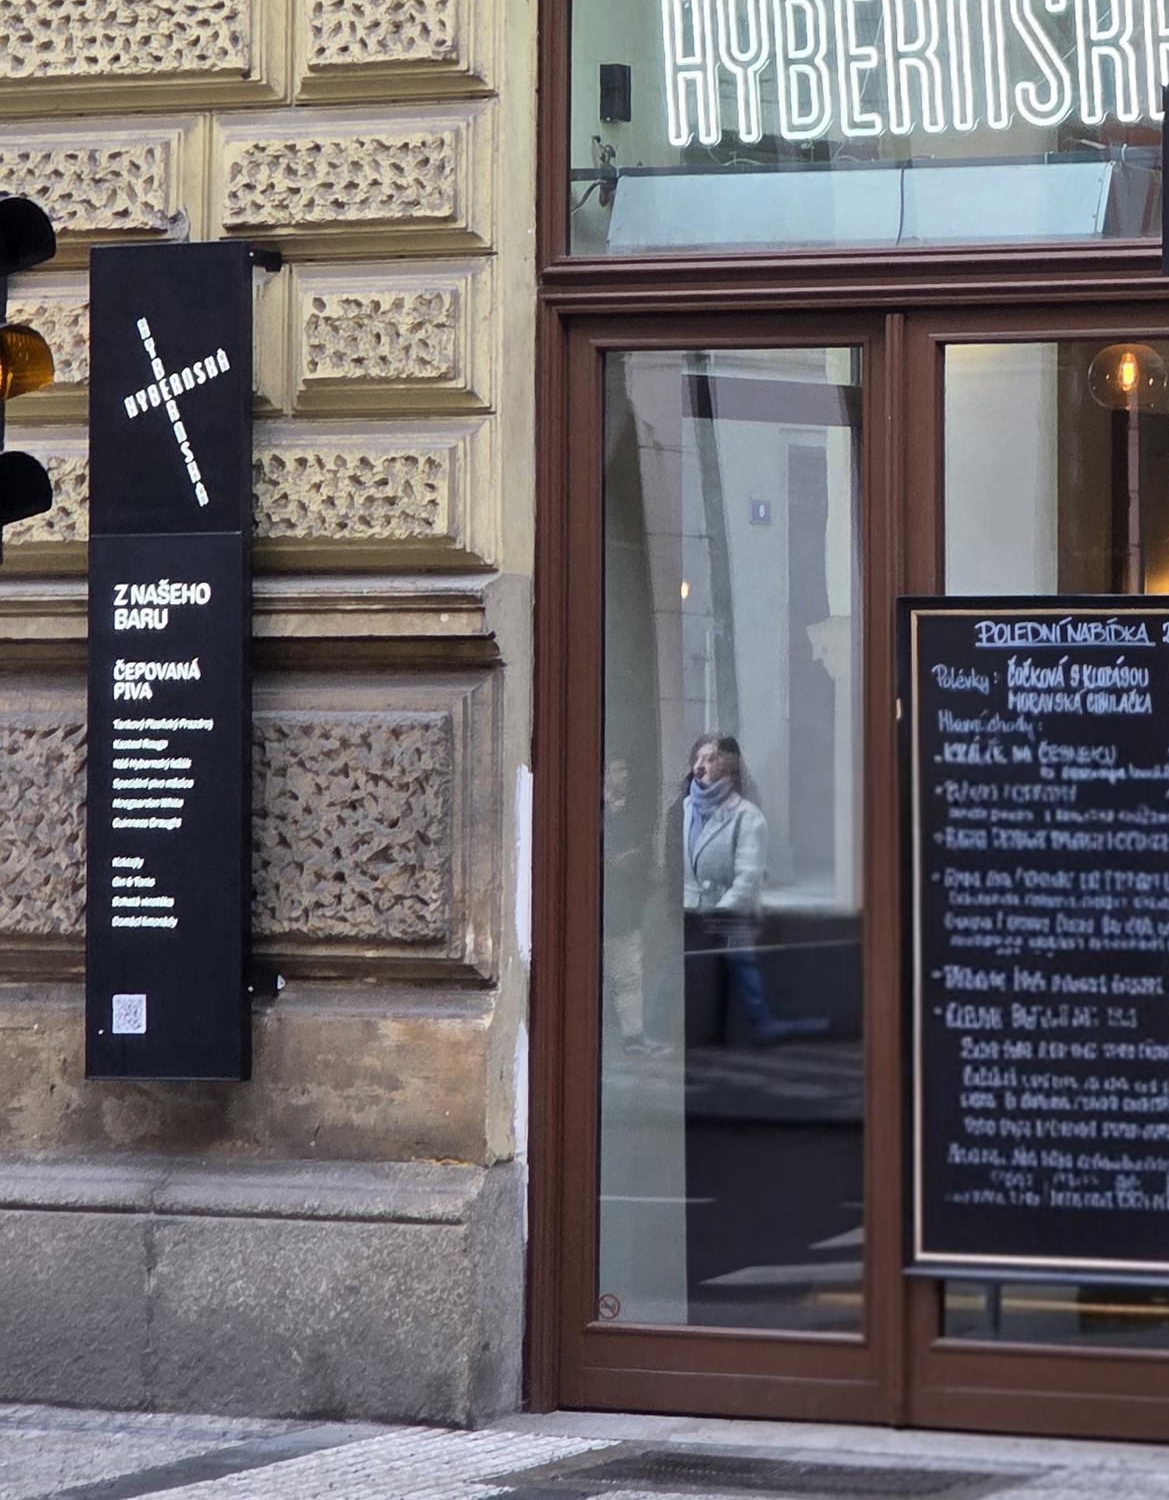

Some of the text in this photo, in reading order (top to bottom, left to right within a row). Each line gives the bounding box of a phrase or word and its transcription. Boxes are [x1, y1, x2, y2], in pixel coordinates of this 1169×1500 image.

[123, 347, 231, 419] HYBERNSKÁ
[113, 579, 211, 606] Z NAŠEHO
[114, 608, 169, 630] BARU
[975, 616, 1072, 644] POLEDNÍ
[1067, 617, 1149, 644] NABÍDKA
[113, 657, 201, 680] ČEPOVANÁ
[1007, 654, 1069, 689] ČOČKOVÁ
[113, 682, 153, 700] PIVA
